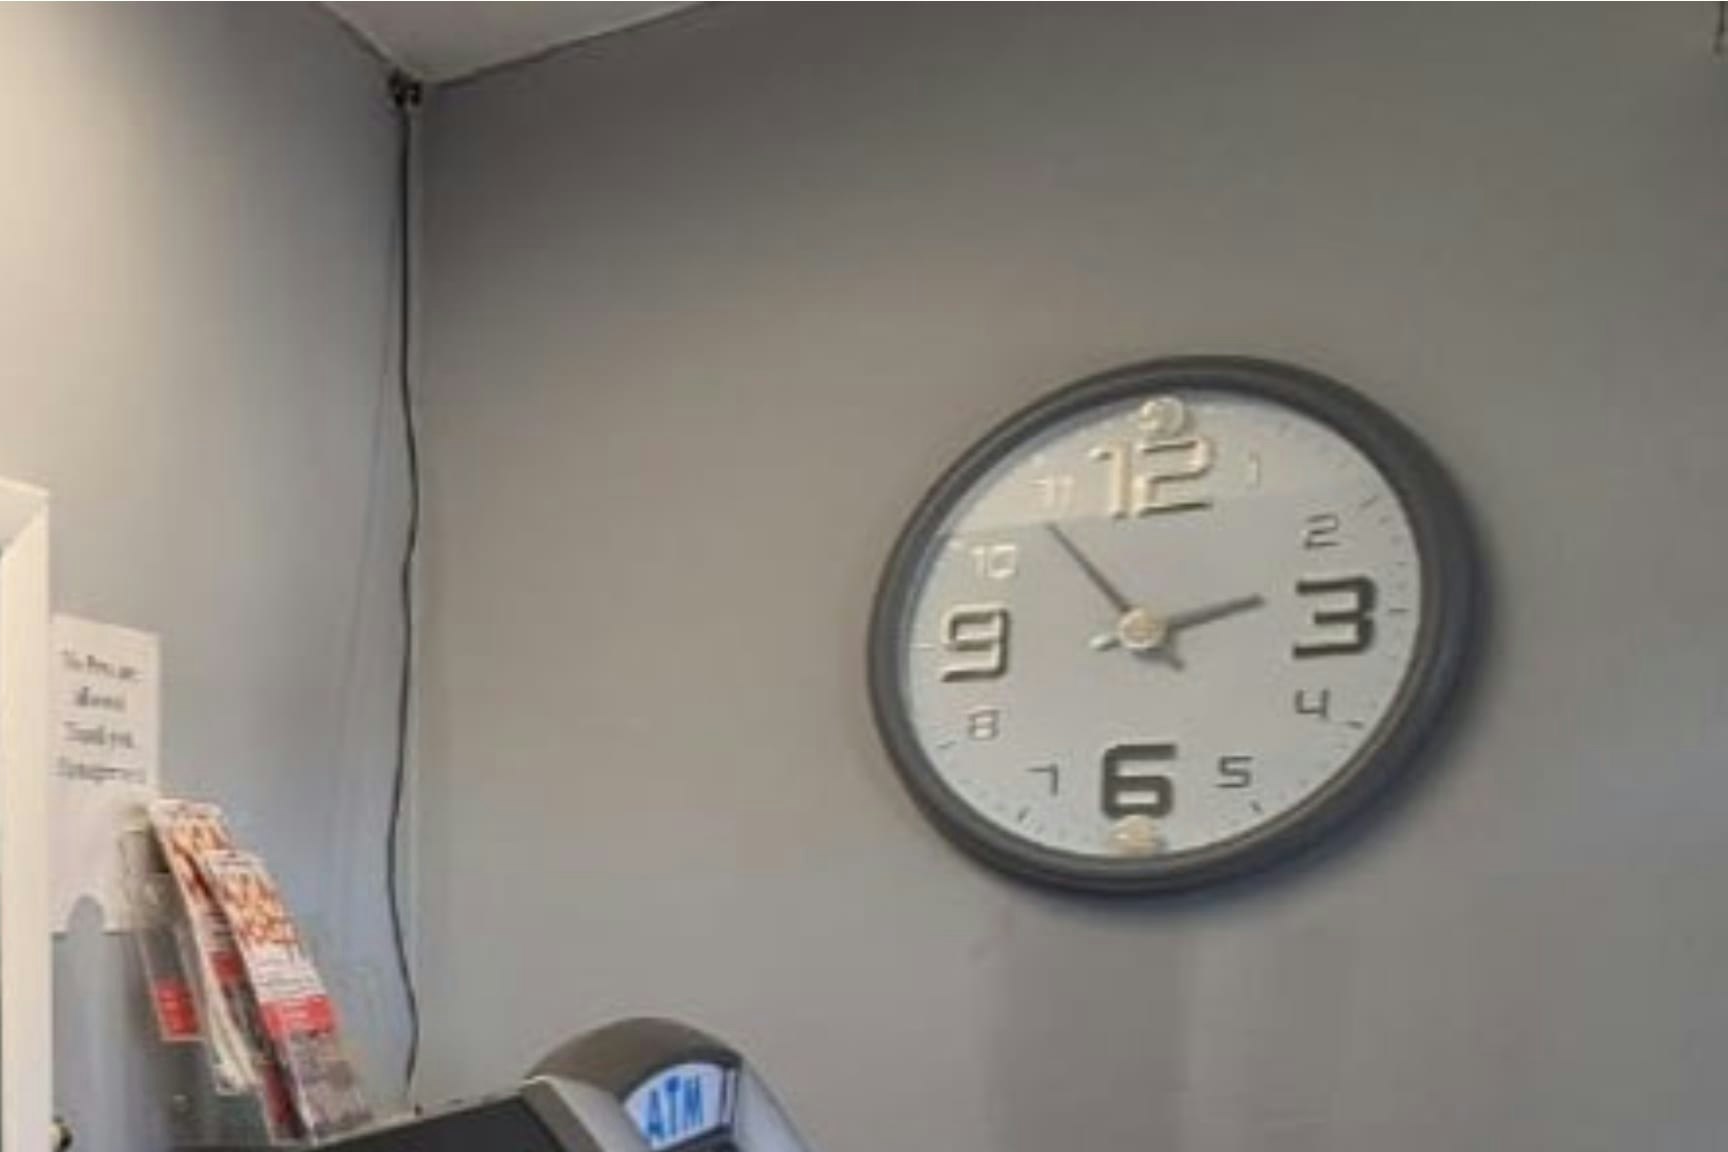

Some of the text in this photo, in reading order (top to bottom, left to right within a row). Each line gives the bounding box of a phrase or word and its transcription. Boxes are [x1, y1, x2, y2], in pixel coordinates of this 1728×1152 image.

[1089, 437, 1213, 518] 12
[1305, 513, 1342, 551] 2
[970, 542, 1019, 580] 10
[1292, 575, 1378, 660] 3
[940, 602, 1010, 685] 9
[1294, 688, 1331, 721] 4
[968, 708, 1000, 741] 8
[1028, 764, 1060, 795] 7
[1100, 742, 1179, 820] 6
[1215, 755, 1255, 789] 5
[644, 1075, 707, 1141] ATM
